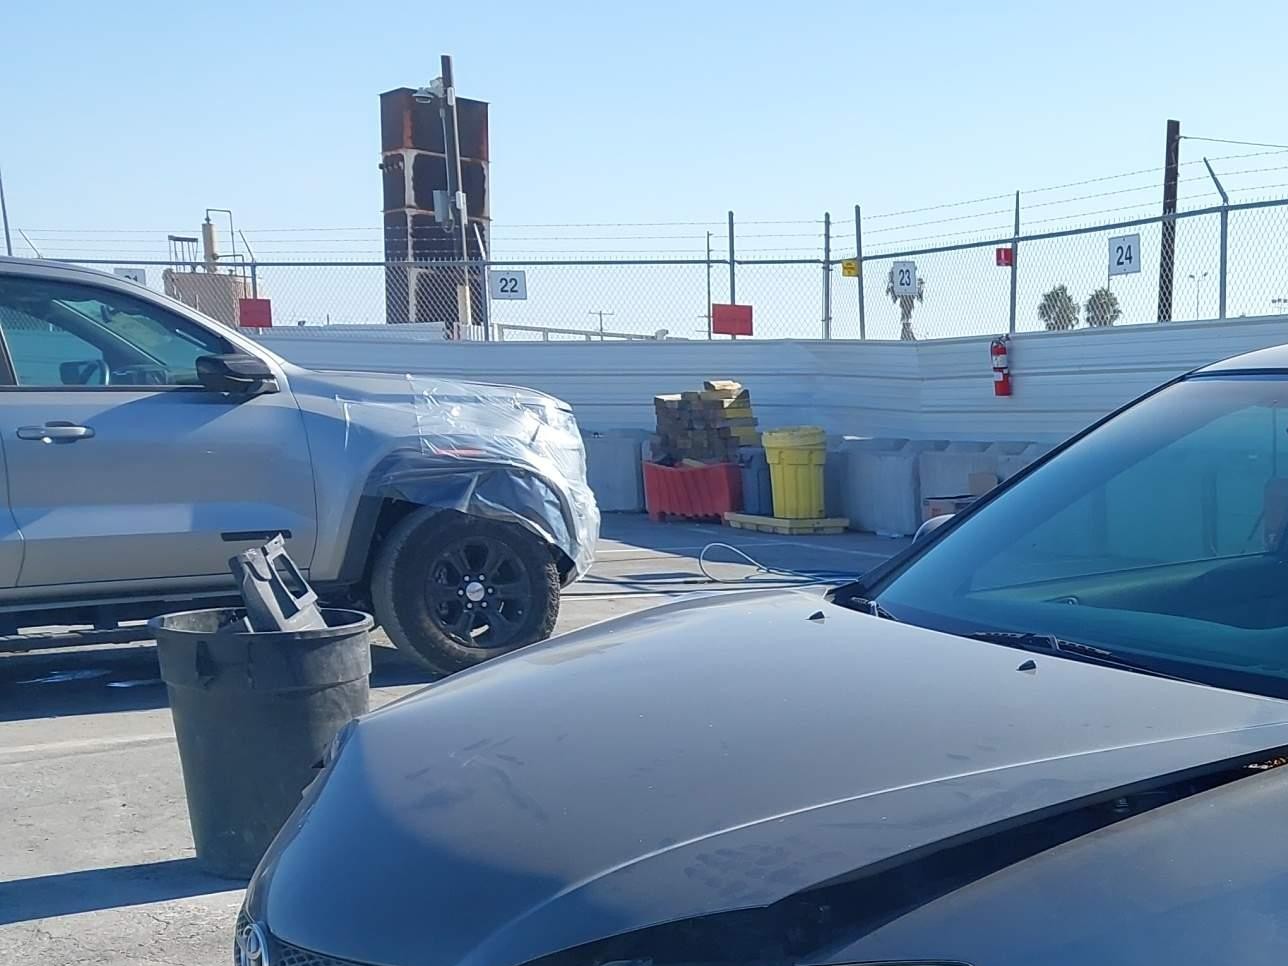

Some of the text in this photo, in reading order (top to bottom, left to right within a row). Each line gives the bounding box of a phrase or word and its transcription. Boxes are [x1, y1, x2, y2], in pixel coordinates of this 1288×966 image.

[1116, 245, 1133, 266] 24
[499, 278, 518, 293] 22
[899, 269, 911, 286] 23
